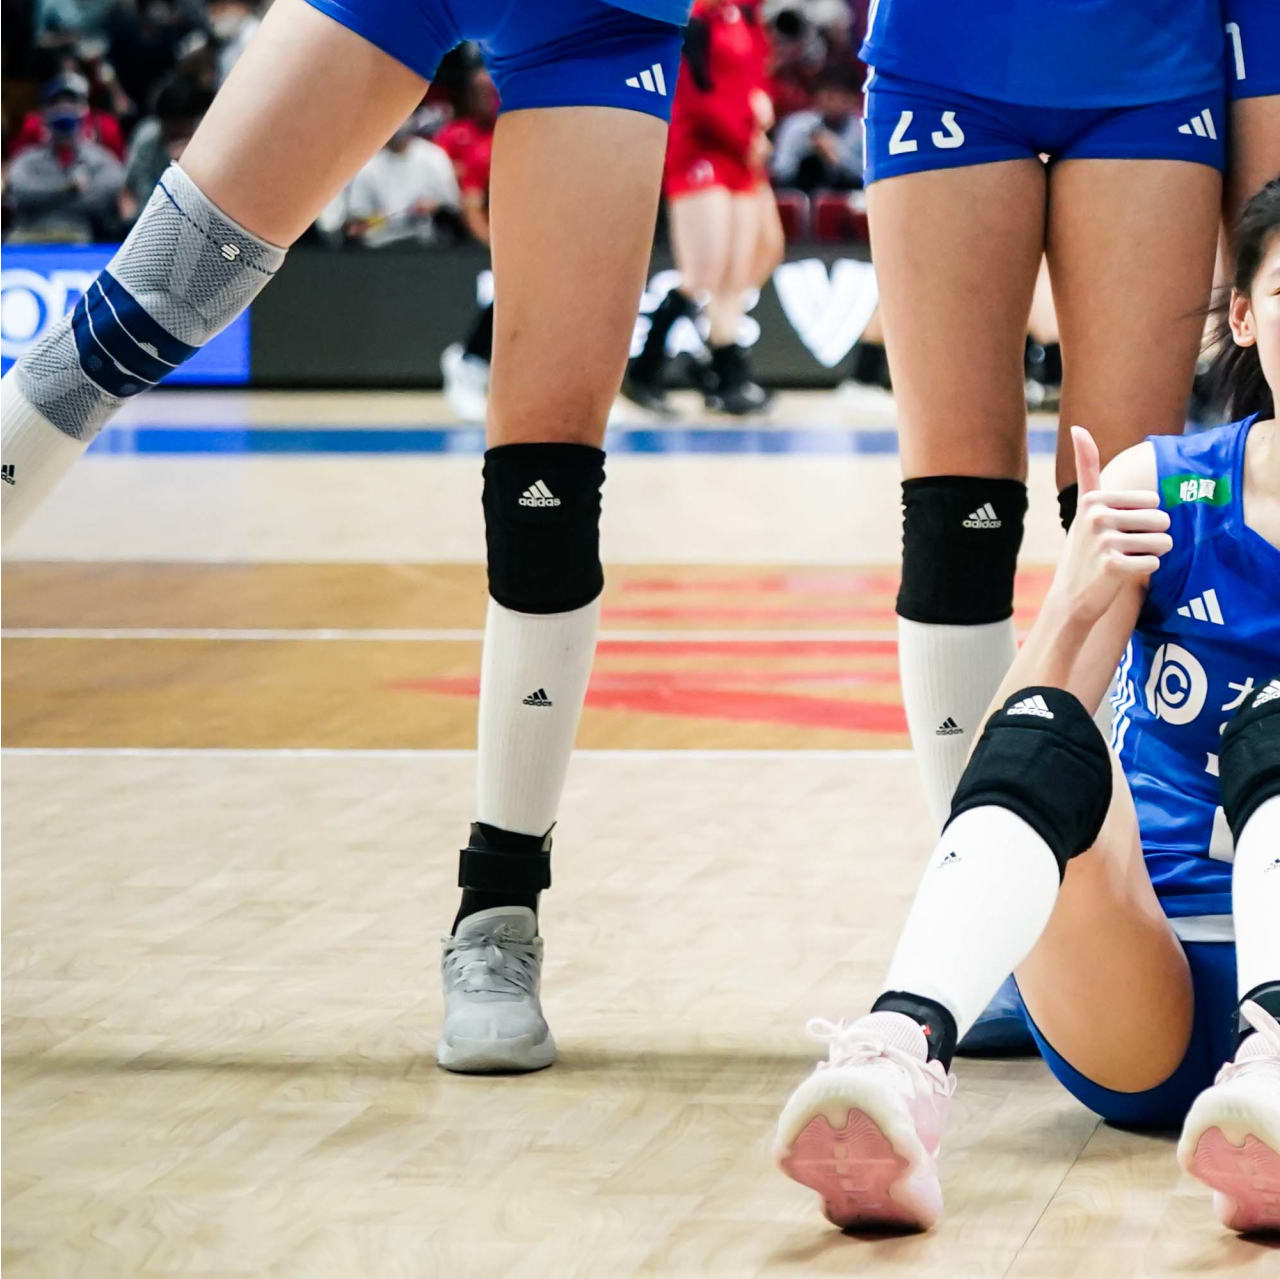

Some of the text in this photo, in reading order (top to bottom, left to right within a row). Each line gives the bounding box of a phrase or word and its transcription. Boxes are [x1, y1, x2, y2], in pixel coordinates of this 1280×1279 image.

[1226, 22, 1246, 81] 1
[519, 497, 561, 507] adidas
[962, 519, 1002, 529] adidas
